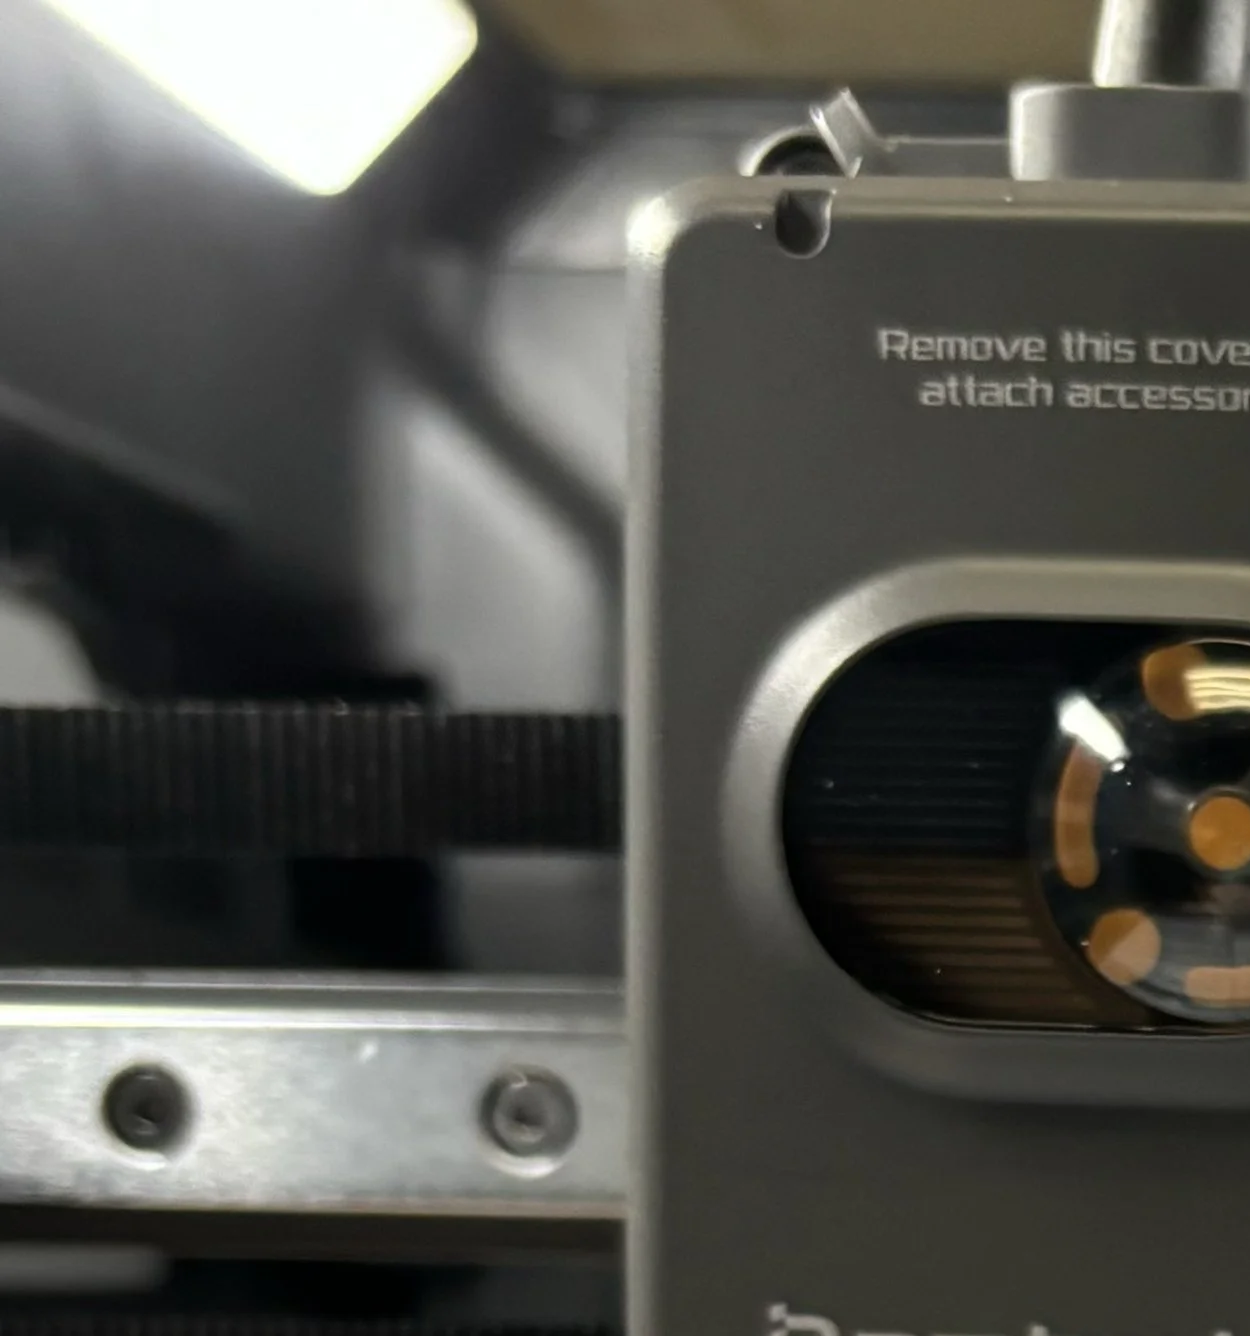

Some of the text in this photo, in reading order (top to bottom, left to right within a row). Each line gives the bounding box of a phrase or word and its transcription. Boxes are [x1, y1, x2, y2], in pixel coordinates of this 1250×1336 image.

[877, 328, 1047, 361] Remove
[1060, 327, 1137, 364] this
[919, 375, 1053, 407] attach
